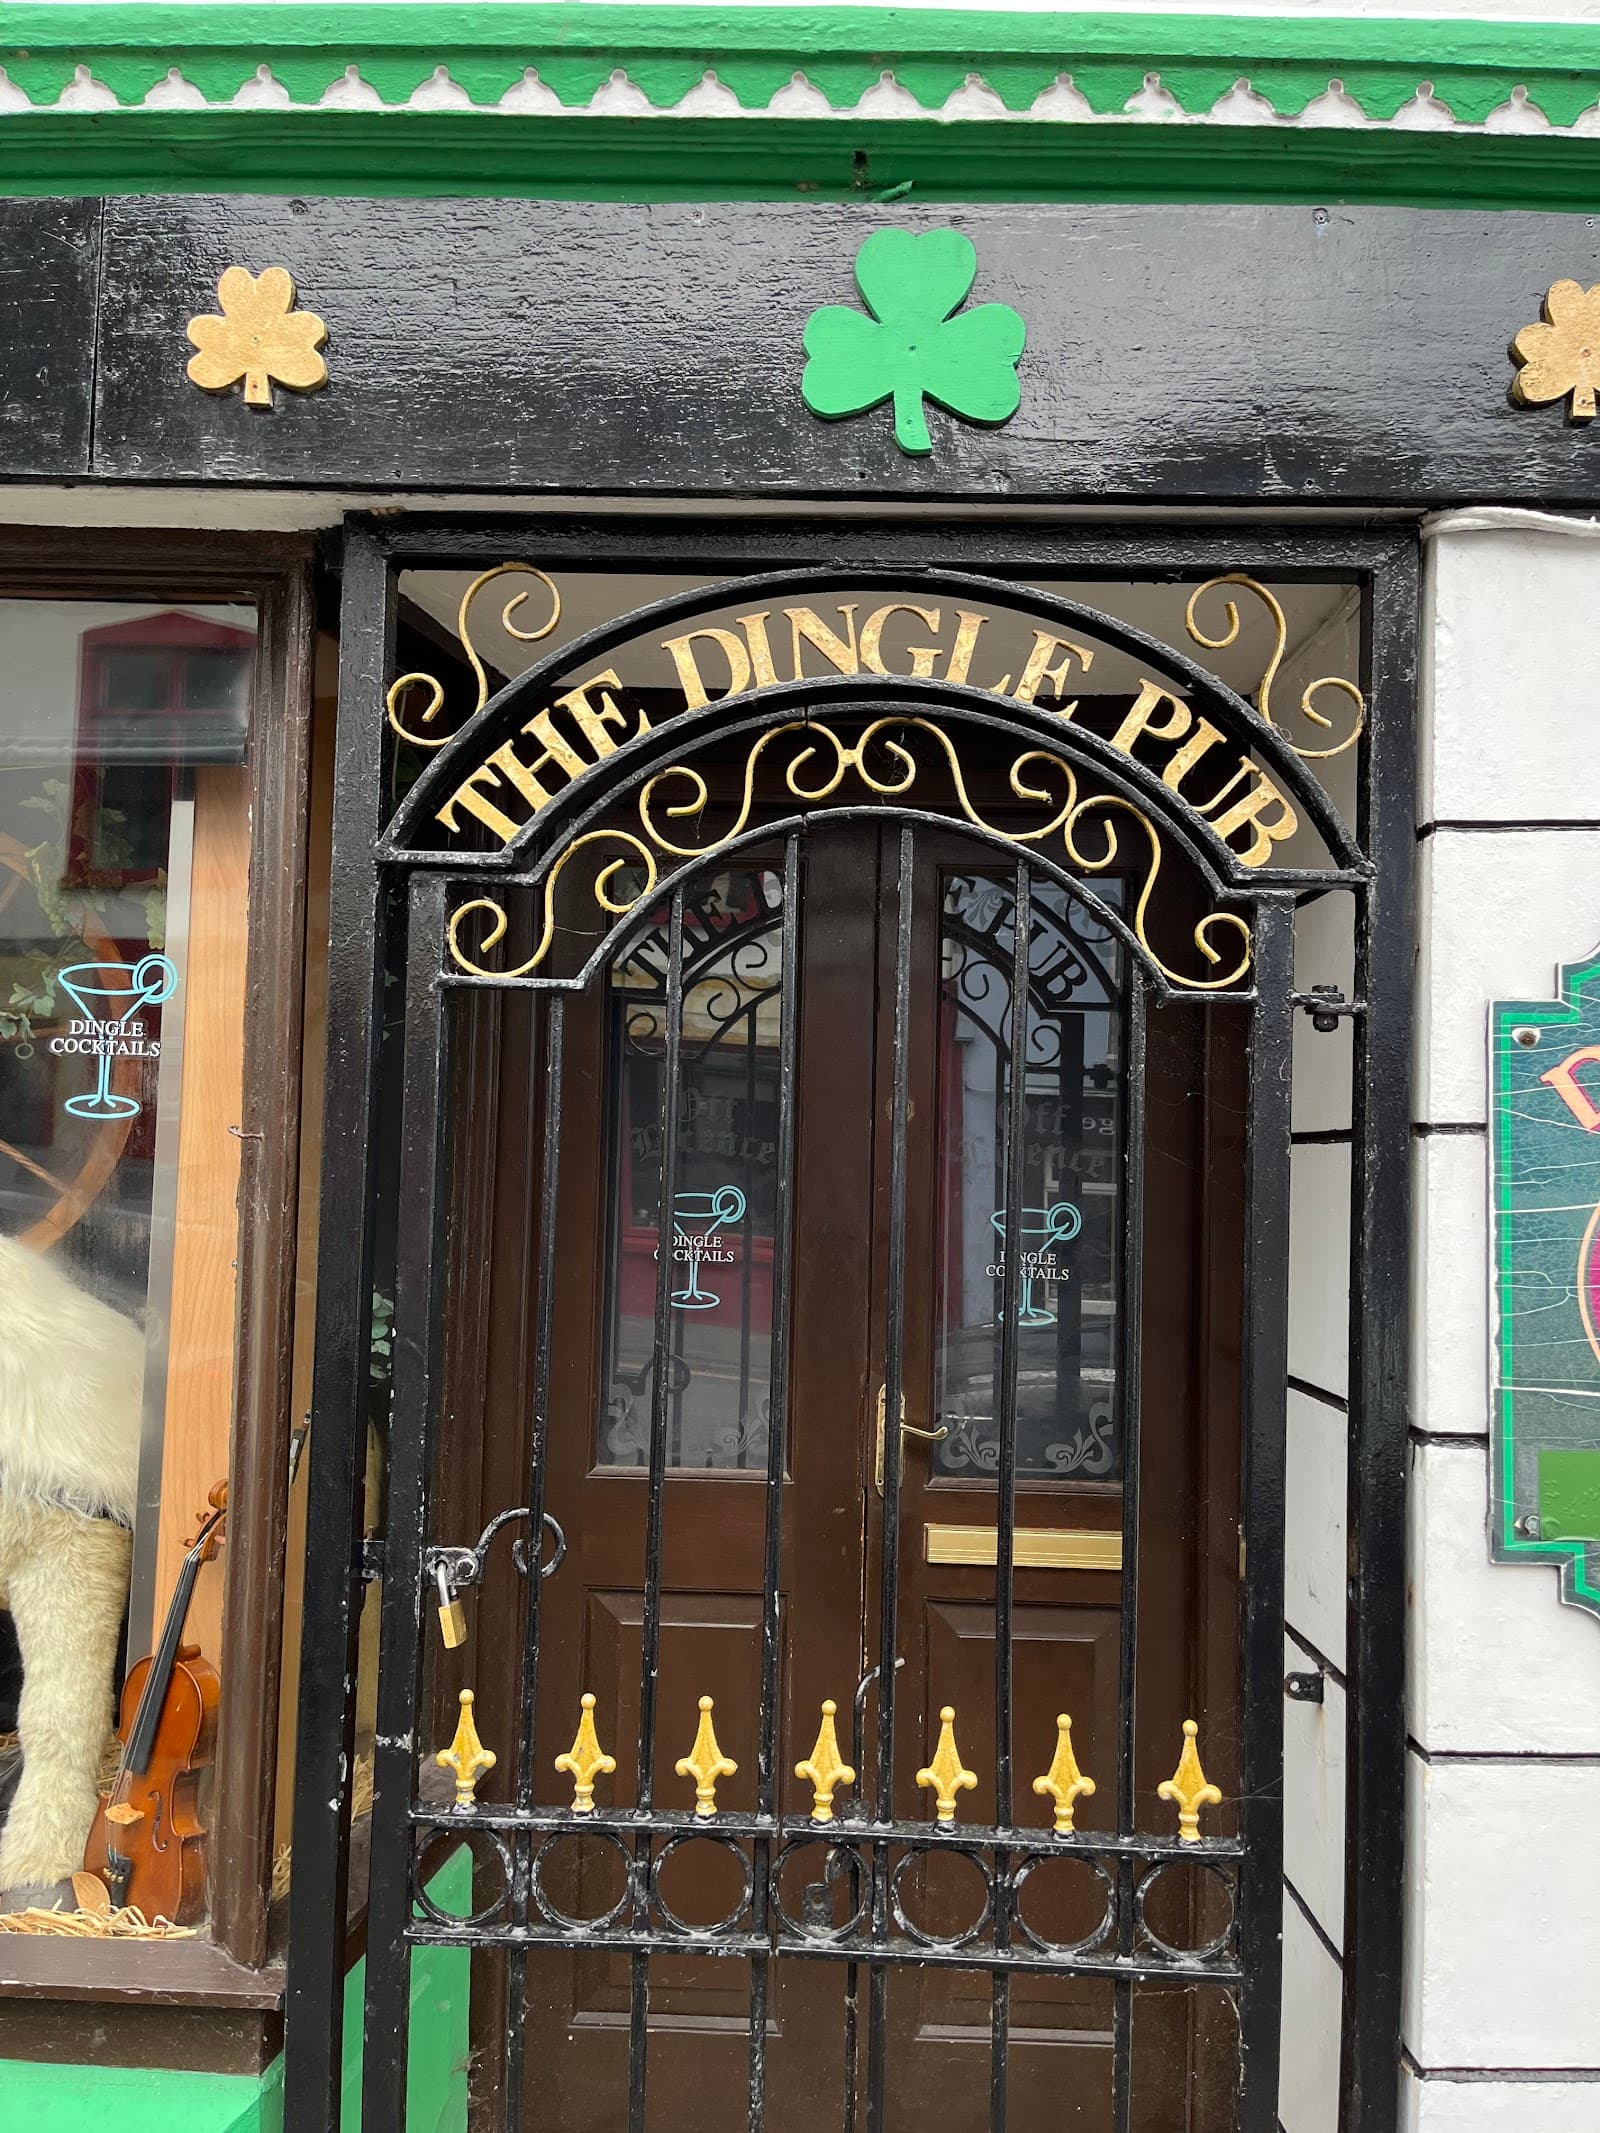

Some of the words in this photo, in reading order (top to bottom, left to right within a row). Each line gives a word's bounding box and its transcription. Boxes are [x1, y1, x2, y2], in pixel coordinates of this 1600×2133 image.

[435, 668, 653, 845] THE
[661, 603, 1095, 720] DINGLE
[1110, 677, 1298, 868] PUB
[69, 1019, 145, 1037] DINGLE
[50, 1038, 161, 1058] COCKTAILS
[630, 1123, 776, 1165] Lcence
[653, 1249, 735, 1263] CKTAILS
[999, 1250, 1057, 1266] NGLE
[985, 1264, 1071, 1281] COKTAILS
